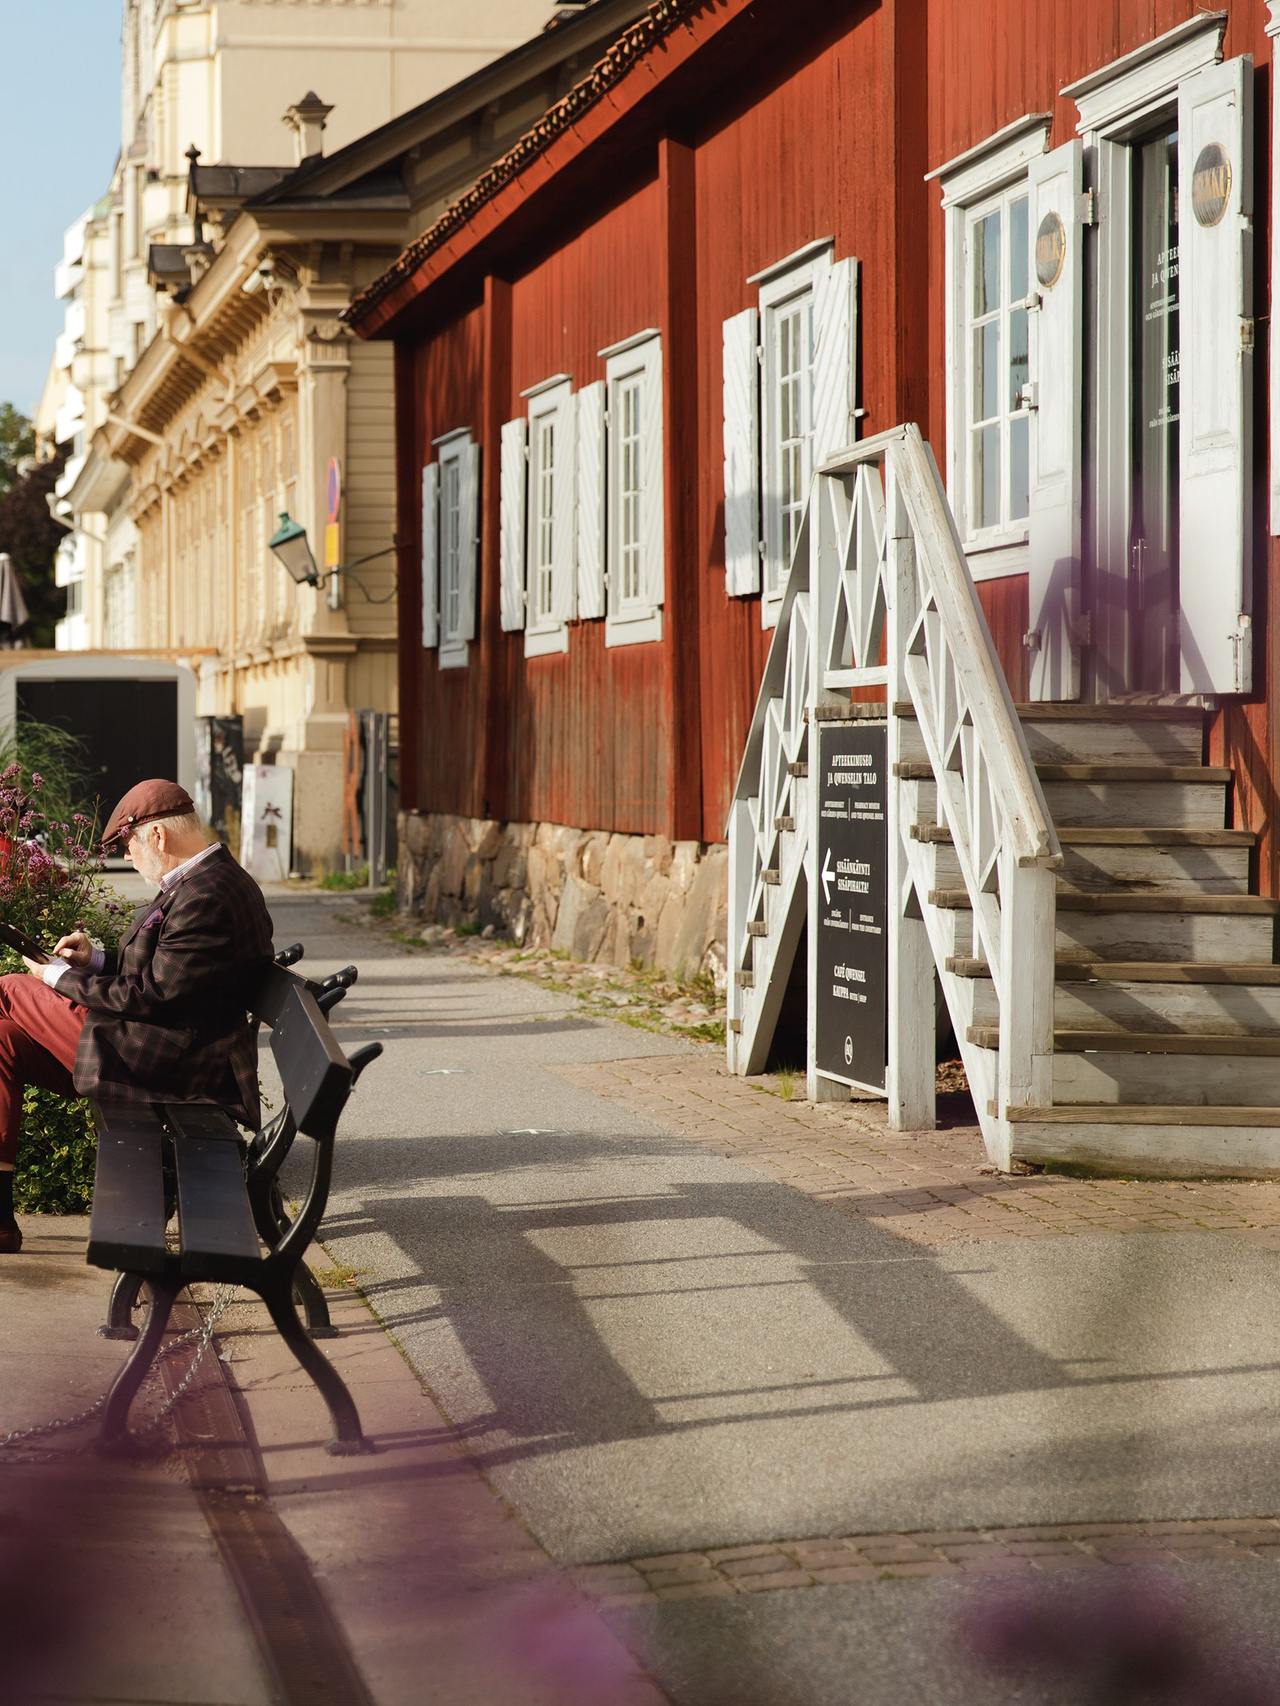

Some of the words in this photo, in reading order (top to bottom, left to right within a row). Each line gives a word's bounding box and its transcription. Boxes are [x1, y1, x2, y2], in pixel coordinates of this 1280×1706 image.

[831, 754, 873, 767] APTEEKKIMUSEO
[827, 772, 833, 787] JA
[833, 772, 862, 787] QWENSELIN
[862, 772, 877, 785] TALO
[836, 858, 871, 876] SISÄÄNKÄYNTI
[833, 962, 845, 978] CAFÉ
[845, 967, 867, 982] QWENSEL
[832, 984, 849, 999] KAUPPA
